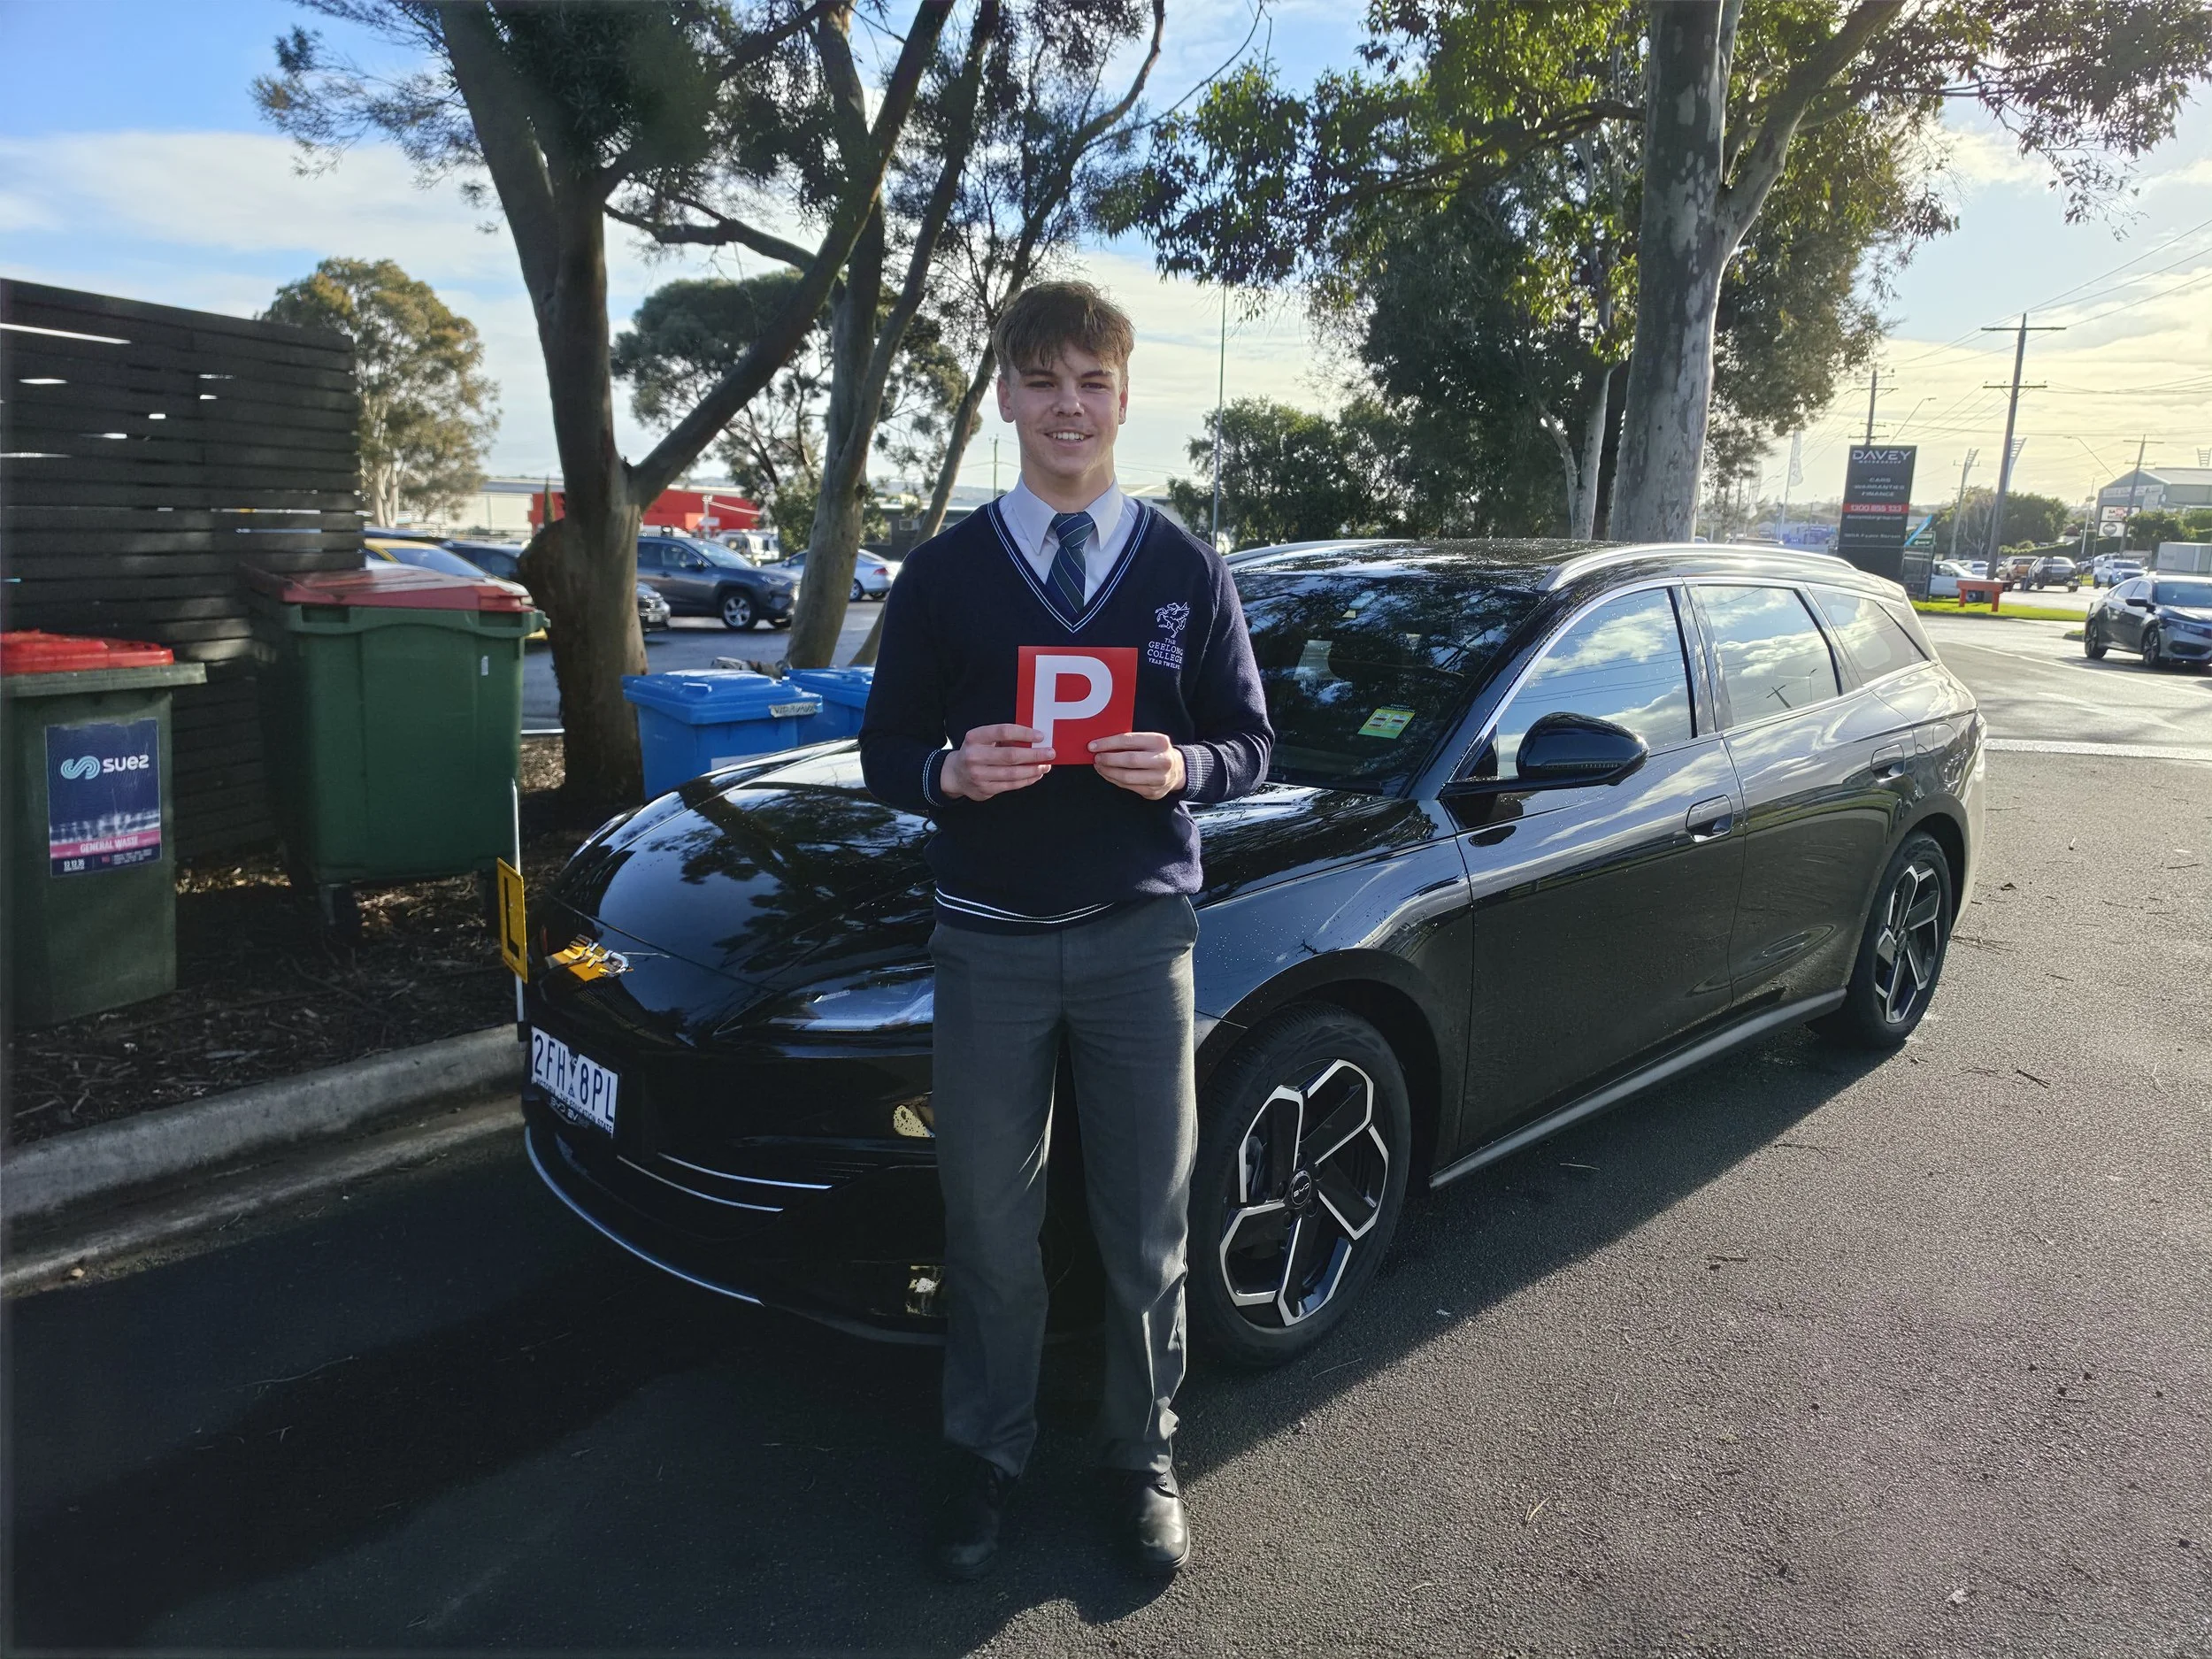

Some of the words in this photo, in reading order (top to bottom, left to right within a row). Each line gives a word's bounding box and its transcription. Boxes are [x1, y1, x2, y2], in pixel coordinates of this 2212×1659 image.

[1853, 449, 1911, 460] DAVEY
[1148, 641, 1184, 656] GEELONG
[1147, 649, 1182, 664] COLLEGE
[1032, 654, 1113, 749] P
[80, 841, 114, 854] GENERAL
[534, 1034, 565, 1091] 2FH
[580, 1063, 614, 1123] 8PL
[597, 1118, 613, 1133] STATE
[1294, 1182, 1310, 1197] BYD
